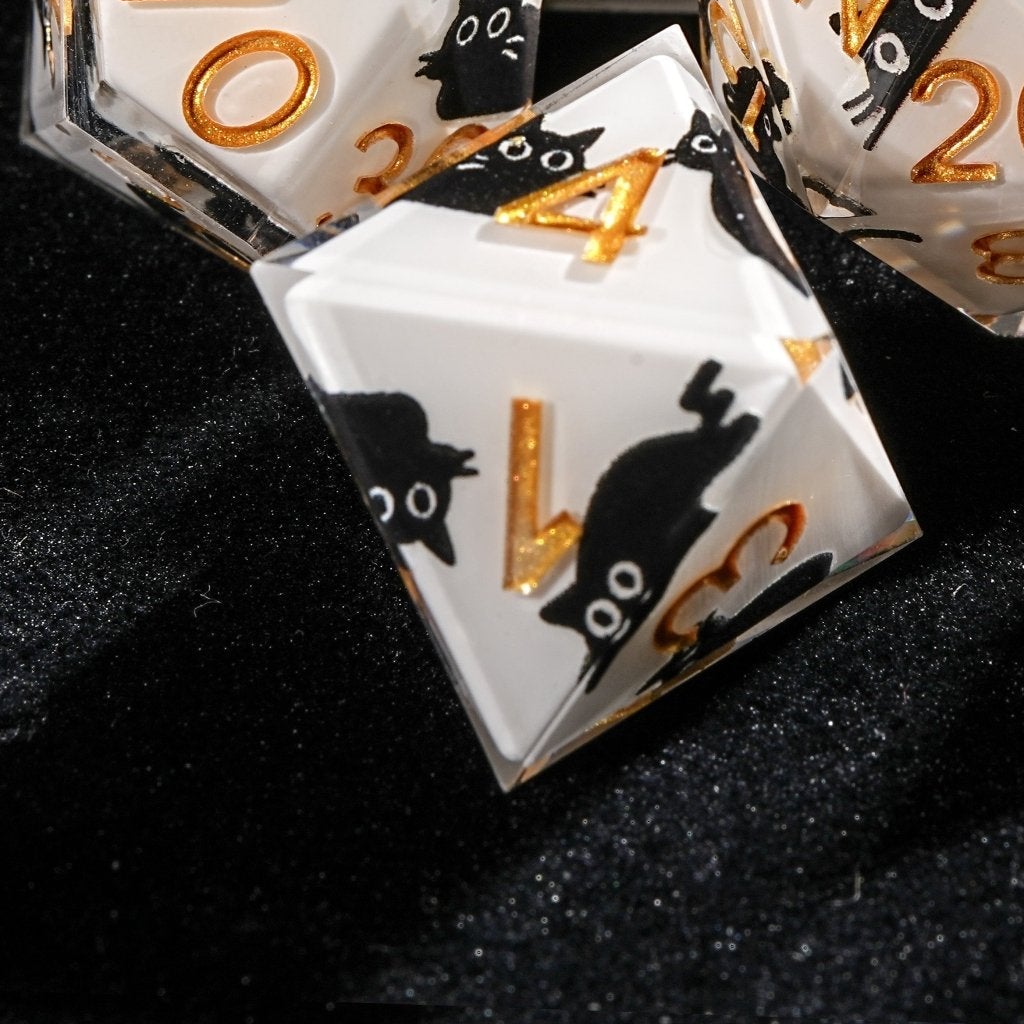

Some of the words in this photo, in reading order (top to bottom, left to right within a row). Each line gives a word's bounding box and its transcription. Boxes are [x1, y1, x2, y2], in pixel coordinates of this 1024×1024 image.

[494, 145, 664, 266] 4
[501, 396, 584, 596] 1
[652, 500, 808, 654] 3
